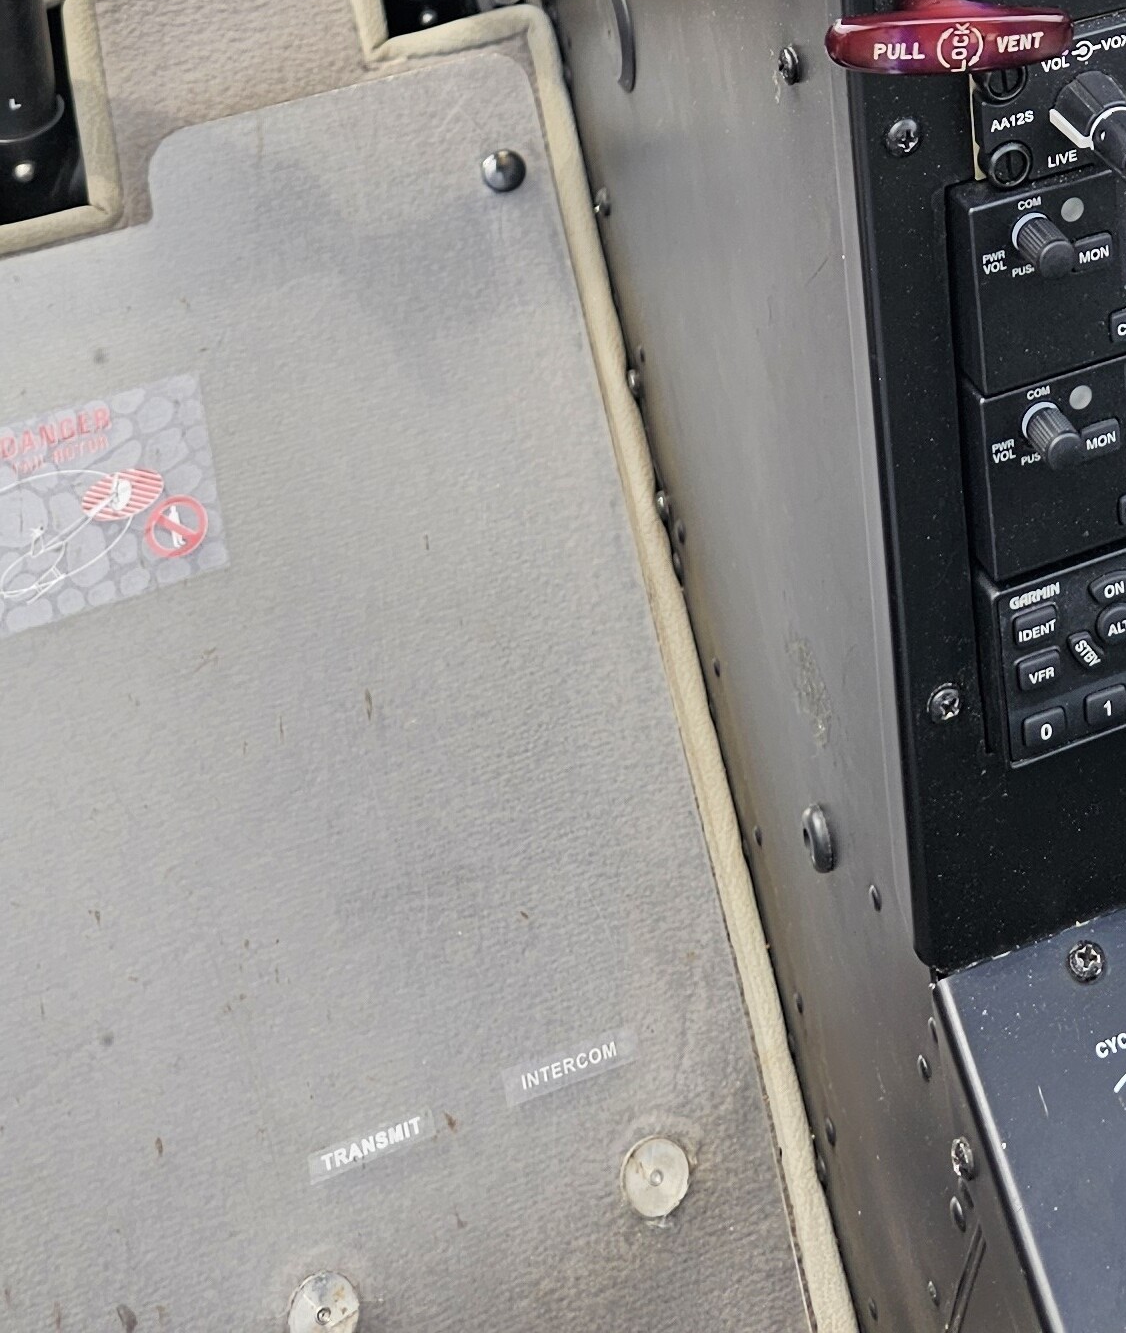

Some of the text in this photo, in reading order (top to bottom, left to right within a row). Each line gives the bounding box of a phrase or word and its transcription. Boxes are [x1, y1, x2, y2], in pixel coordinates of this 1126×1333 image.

[873, 42, 925, 60] PULL
[996, 31, 1044, 53] VENT
[990, 109, 1035, 132] AA12S
[1047, 149, 1078, 167] LIVE
[1079, 245, 1110, 264] MON
[1009, 582, 1060, 611] GARMIN
[1104, 581, 1125, 599] ON
[1018, 619, 1056, 643] IDENT
[1029, 666, 1055, 684] VFR
[521, 1041, 618, 1090] INTERCOM
[321, 1116, 422, 1171] TRANSMIT
